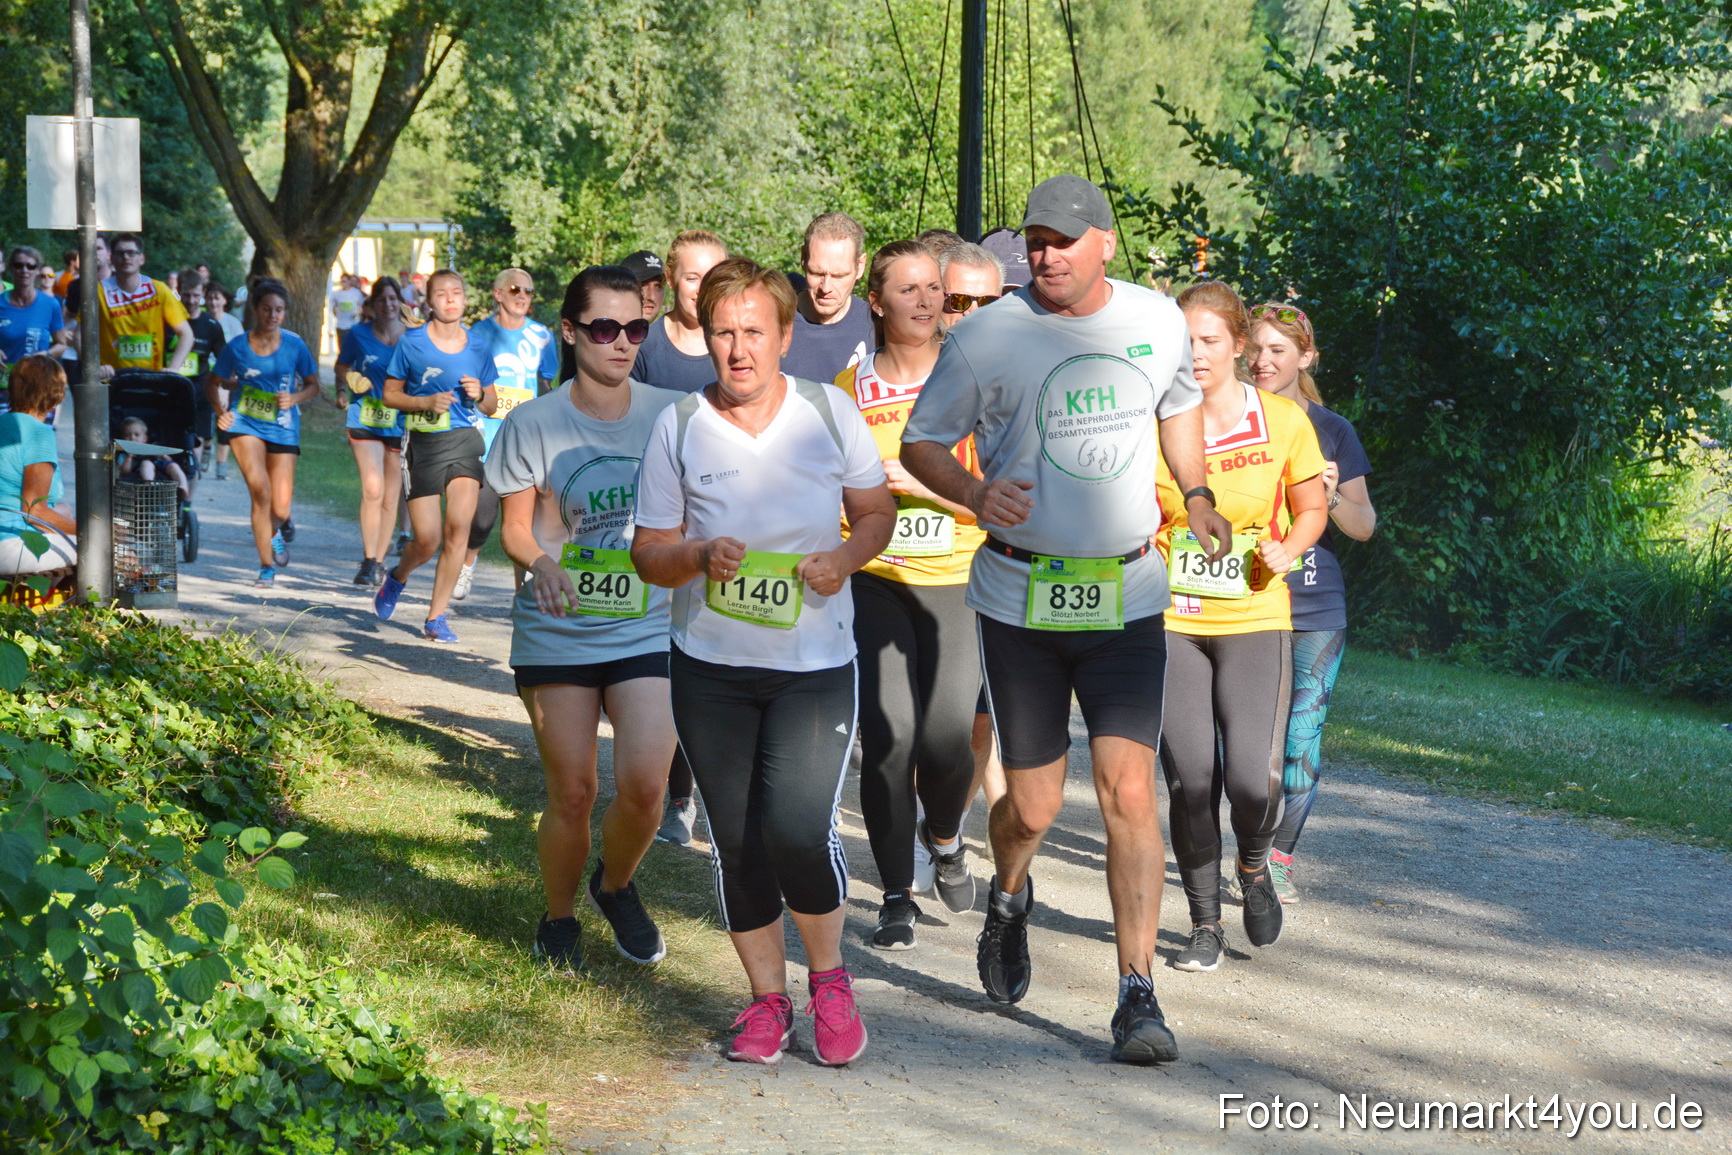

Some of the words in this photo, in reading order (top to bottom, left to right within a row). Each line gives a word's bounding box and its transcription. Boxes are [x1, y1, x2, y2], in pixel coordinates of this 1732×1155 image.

[122, 343, 148, 353] 1311
[244, 397, 273, 413] 1798
[364, 406, 391, 421] 1796
[1048, 409, 1063, 418] DAS
[1058, 419, 1074, 428] DER
[1076, 407, 1148, 426] NEPHROLOGISCHE
[1048, 422, 1133, 439] GESAMTVERSORGER.
[1220, 451, 1274, 473] BÖGL
[572, 508, 587, 516] DAS
[588, 484, 635, 514] KfH
[582, 516, 597, 525] DER
[600, 509, 634, 520] NEPHRO
[1178, 550, 1240, 580] 1308
[578, 571, 631, 598] 840
[1187, 576, 1204, 584] Stich
[1204, 578, 1227, 586] Kristin
[1049, 583, 1101, 610] 839
[727, 599, 750, 610] Lerzer
[752, 604, 774, 614] Birgit
[1051, 610, 1073, 618] Glötzl
